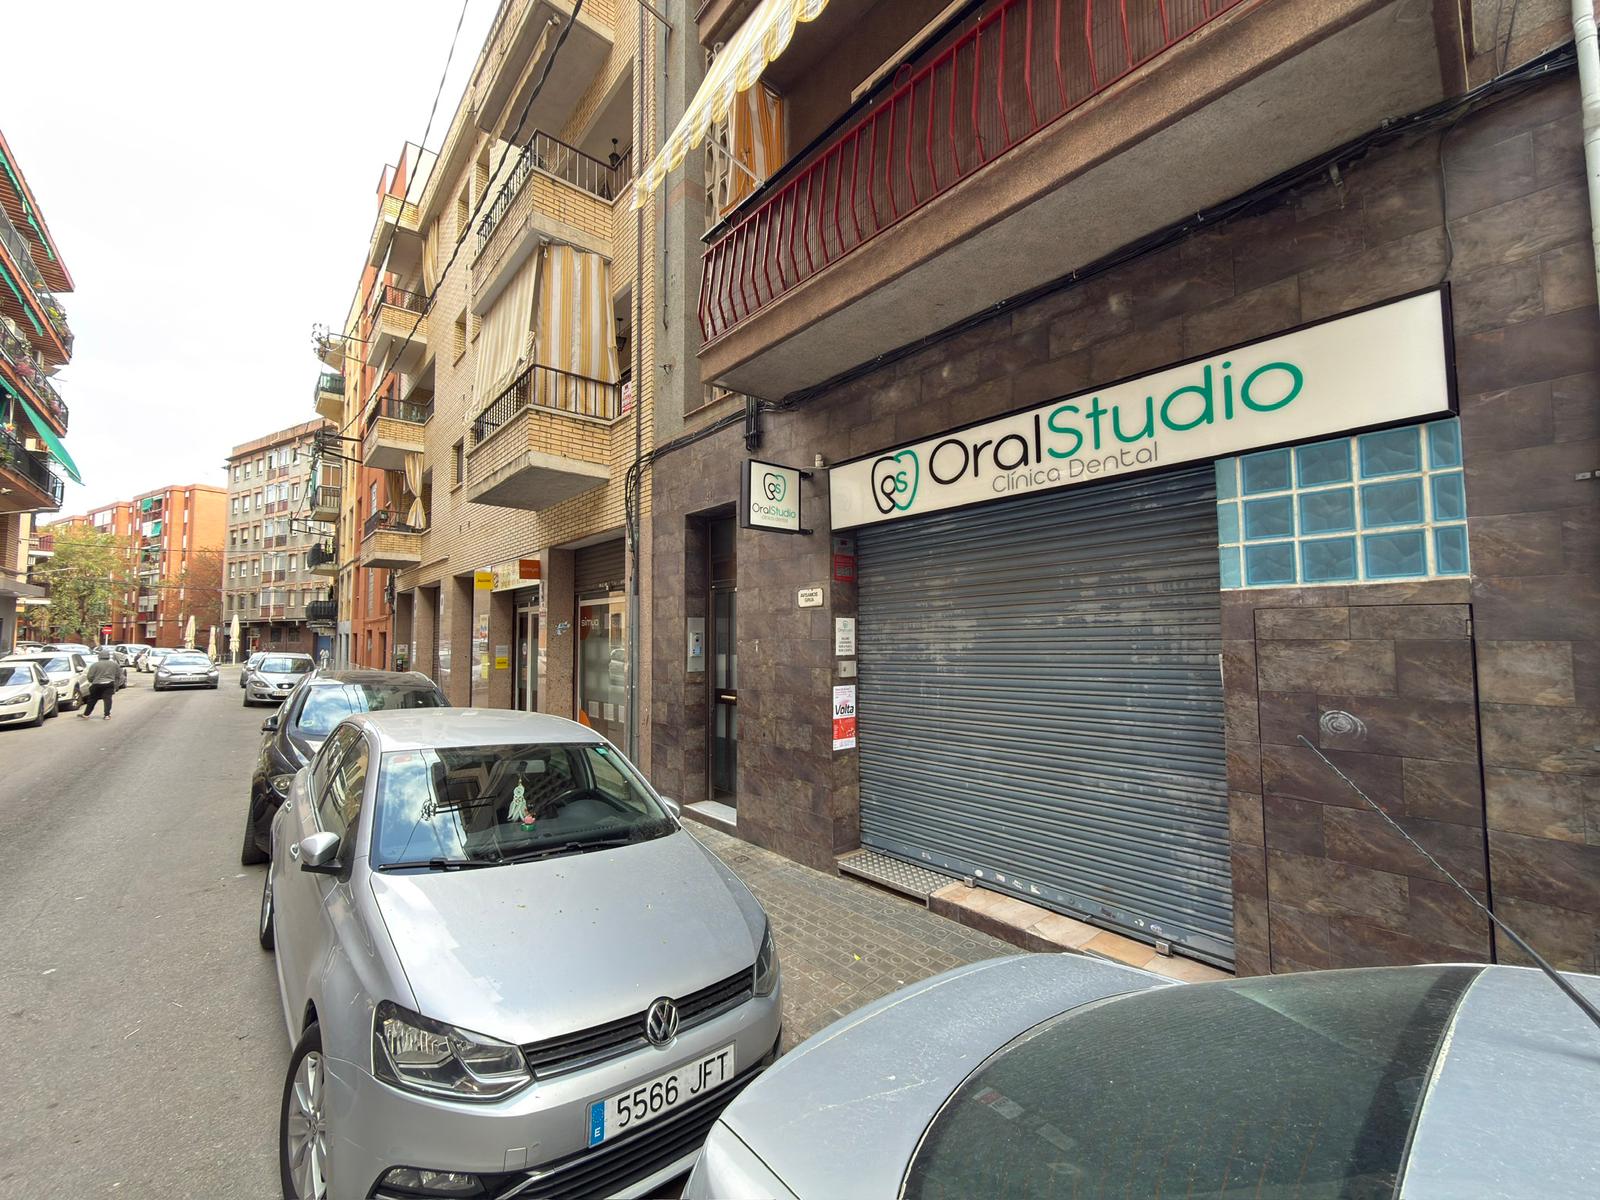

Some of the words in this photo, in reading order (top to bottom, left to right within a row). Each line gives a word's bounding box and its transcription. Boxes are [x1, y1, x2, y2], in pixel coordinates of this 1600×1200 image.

[928, 360, 1304, 486] OralStudio
[992, 463, 1061, 494] Clínica
[1069, 441, 1159, 481] Dental
[752, 502, 796, 518] OralStudio
[835, 703, 854, 715] Volta
[617, 1075, 678, 1127] 5566
[690, 1051, 729, 1094] JFT
[594, 1127, 601, 1138] E
